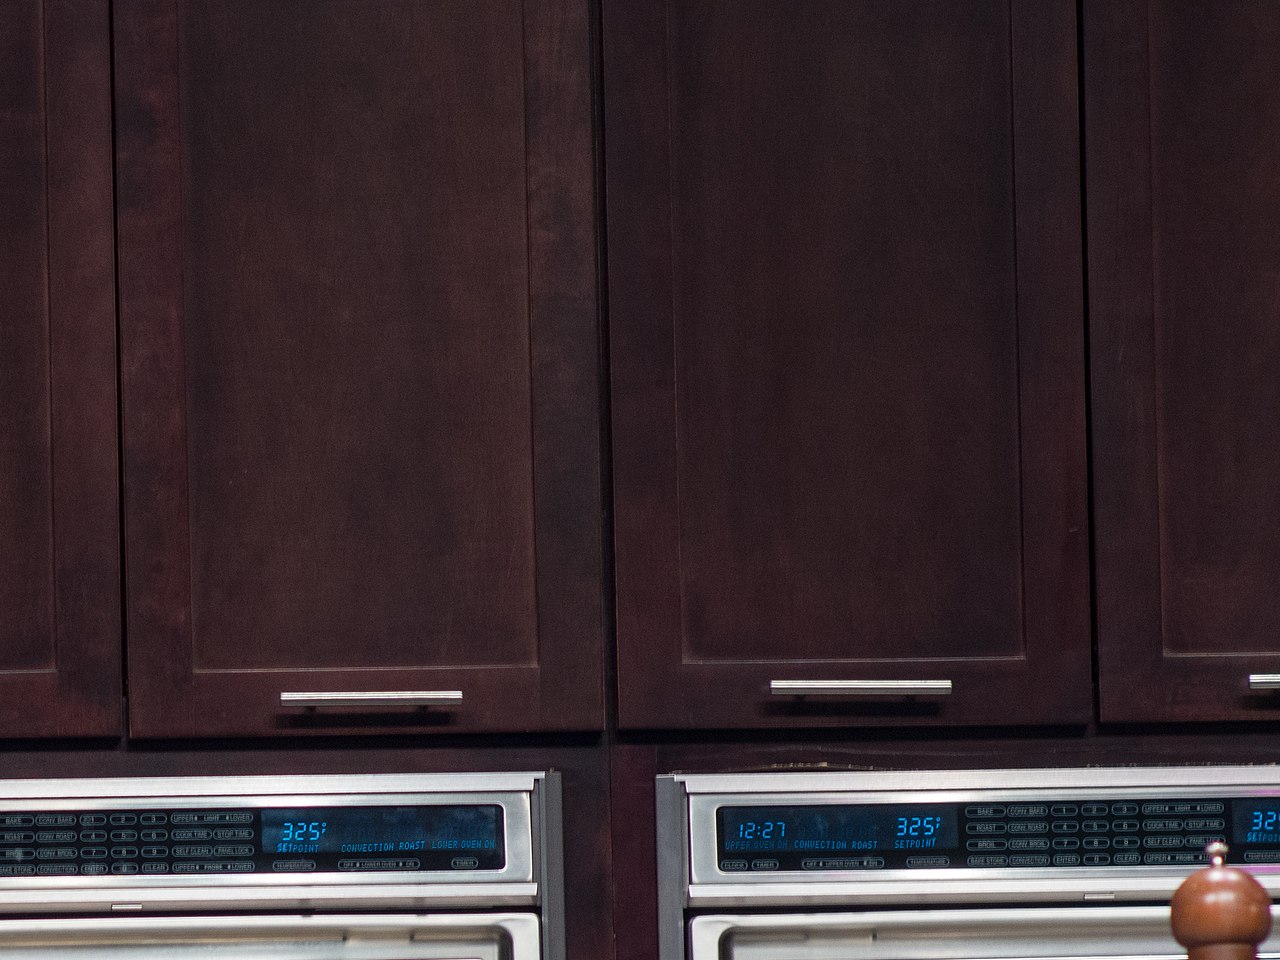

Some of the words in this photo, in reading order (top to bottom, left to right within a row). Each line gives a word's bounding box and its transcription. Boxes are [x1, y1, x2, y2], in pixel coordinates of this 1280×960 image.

[1252, 811, 1280, 830] 32
[739, 822, 785, 838] 12:27
[1247, 831, 1280, 842] SETPOI
[341, 844, 394, 852] CONVECTION
[399, 841, 425, 850] ROAST
[793, 840, 846, 849] CONVECTION
[852, 840, 877, 849] ROAST
[895, 838, 936, 849] SETPOINT
